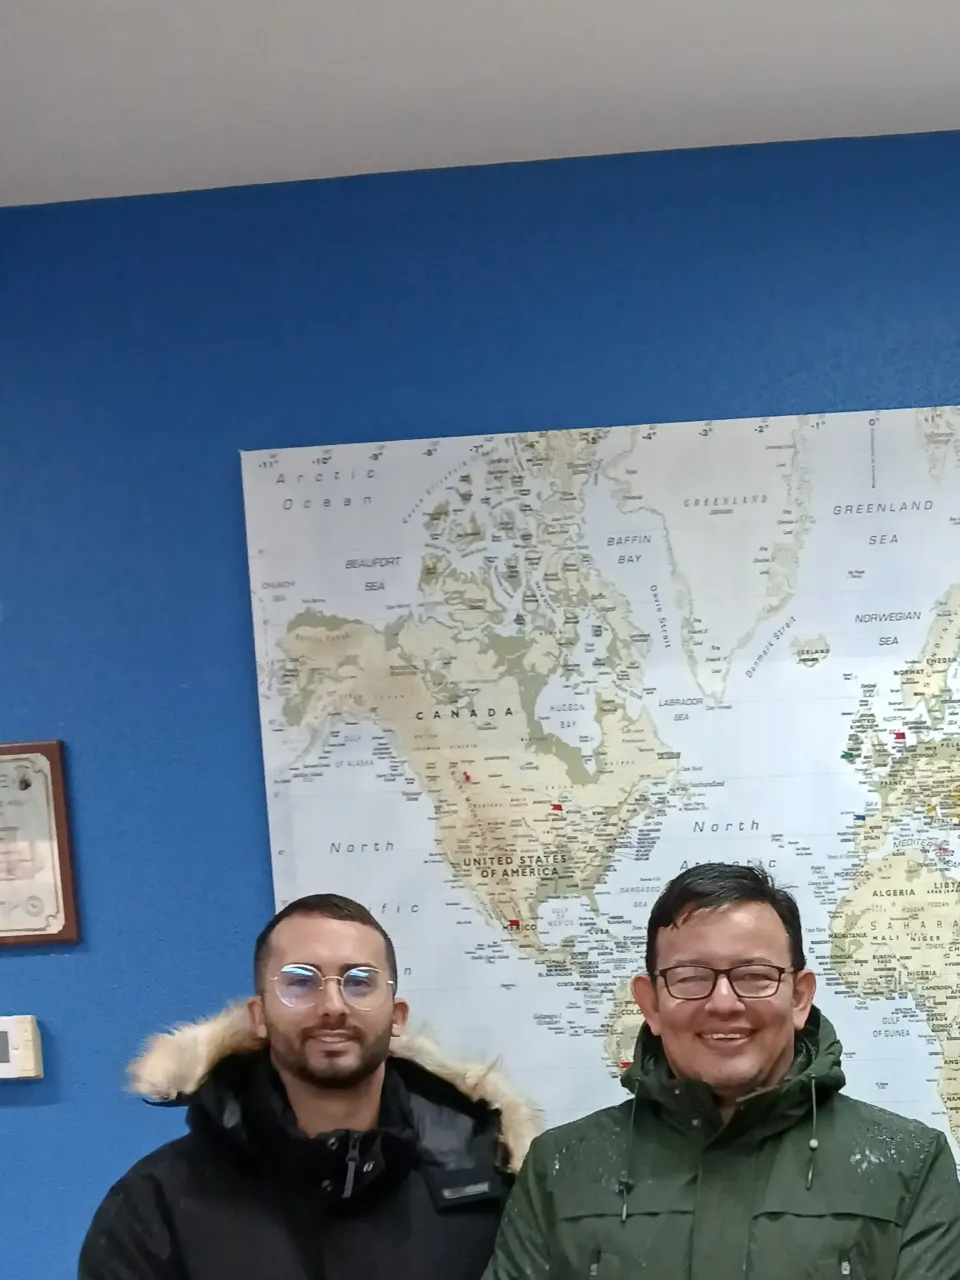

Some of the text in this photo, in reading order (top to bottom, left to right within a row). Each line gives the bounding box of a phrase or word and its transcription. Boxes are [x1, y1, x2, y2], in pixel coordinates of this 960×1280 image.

[276, 469, 376, 484] Arctic
[283, 496, 372, 510] Ocean
[833, 500, 934, 516] GREENLAND
[606, 534, 652, 547] BAFFIN
[869, 534, 899, 545] SEA
[345, 556, 402, 569] BEAUFORT
[618, 554, 643, 565] BAY
[364, 582, 385, 591] SEA
[855, 611, 921, 623] NORWEGIAN
[659, 617, 671, 649] Strait
[746, 615, 797, 679] Denmark Strait
[878, 636, 899, 646] SEA
[658, 698, 704, 708] LABRADOR
[416, 707, 513, 721] CANADA
[674, 714, 689, 722] SEA
[693, 820, 760, 833] North
[330, 841, 395, 855] North
[463, 855, 567, 867] UNITED STATES
[481, 868, 559, 878] OF AMERICA
[872, 889, 915, 897] ALGERIA
[870, 919, 959, 931] SAHARA
[882, 1016, 901, 1025] GULF
[873, 1029, 911, 1038] OF GUINEA
